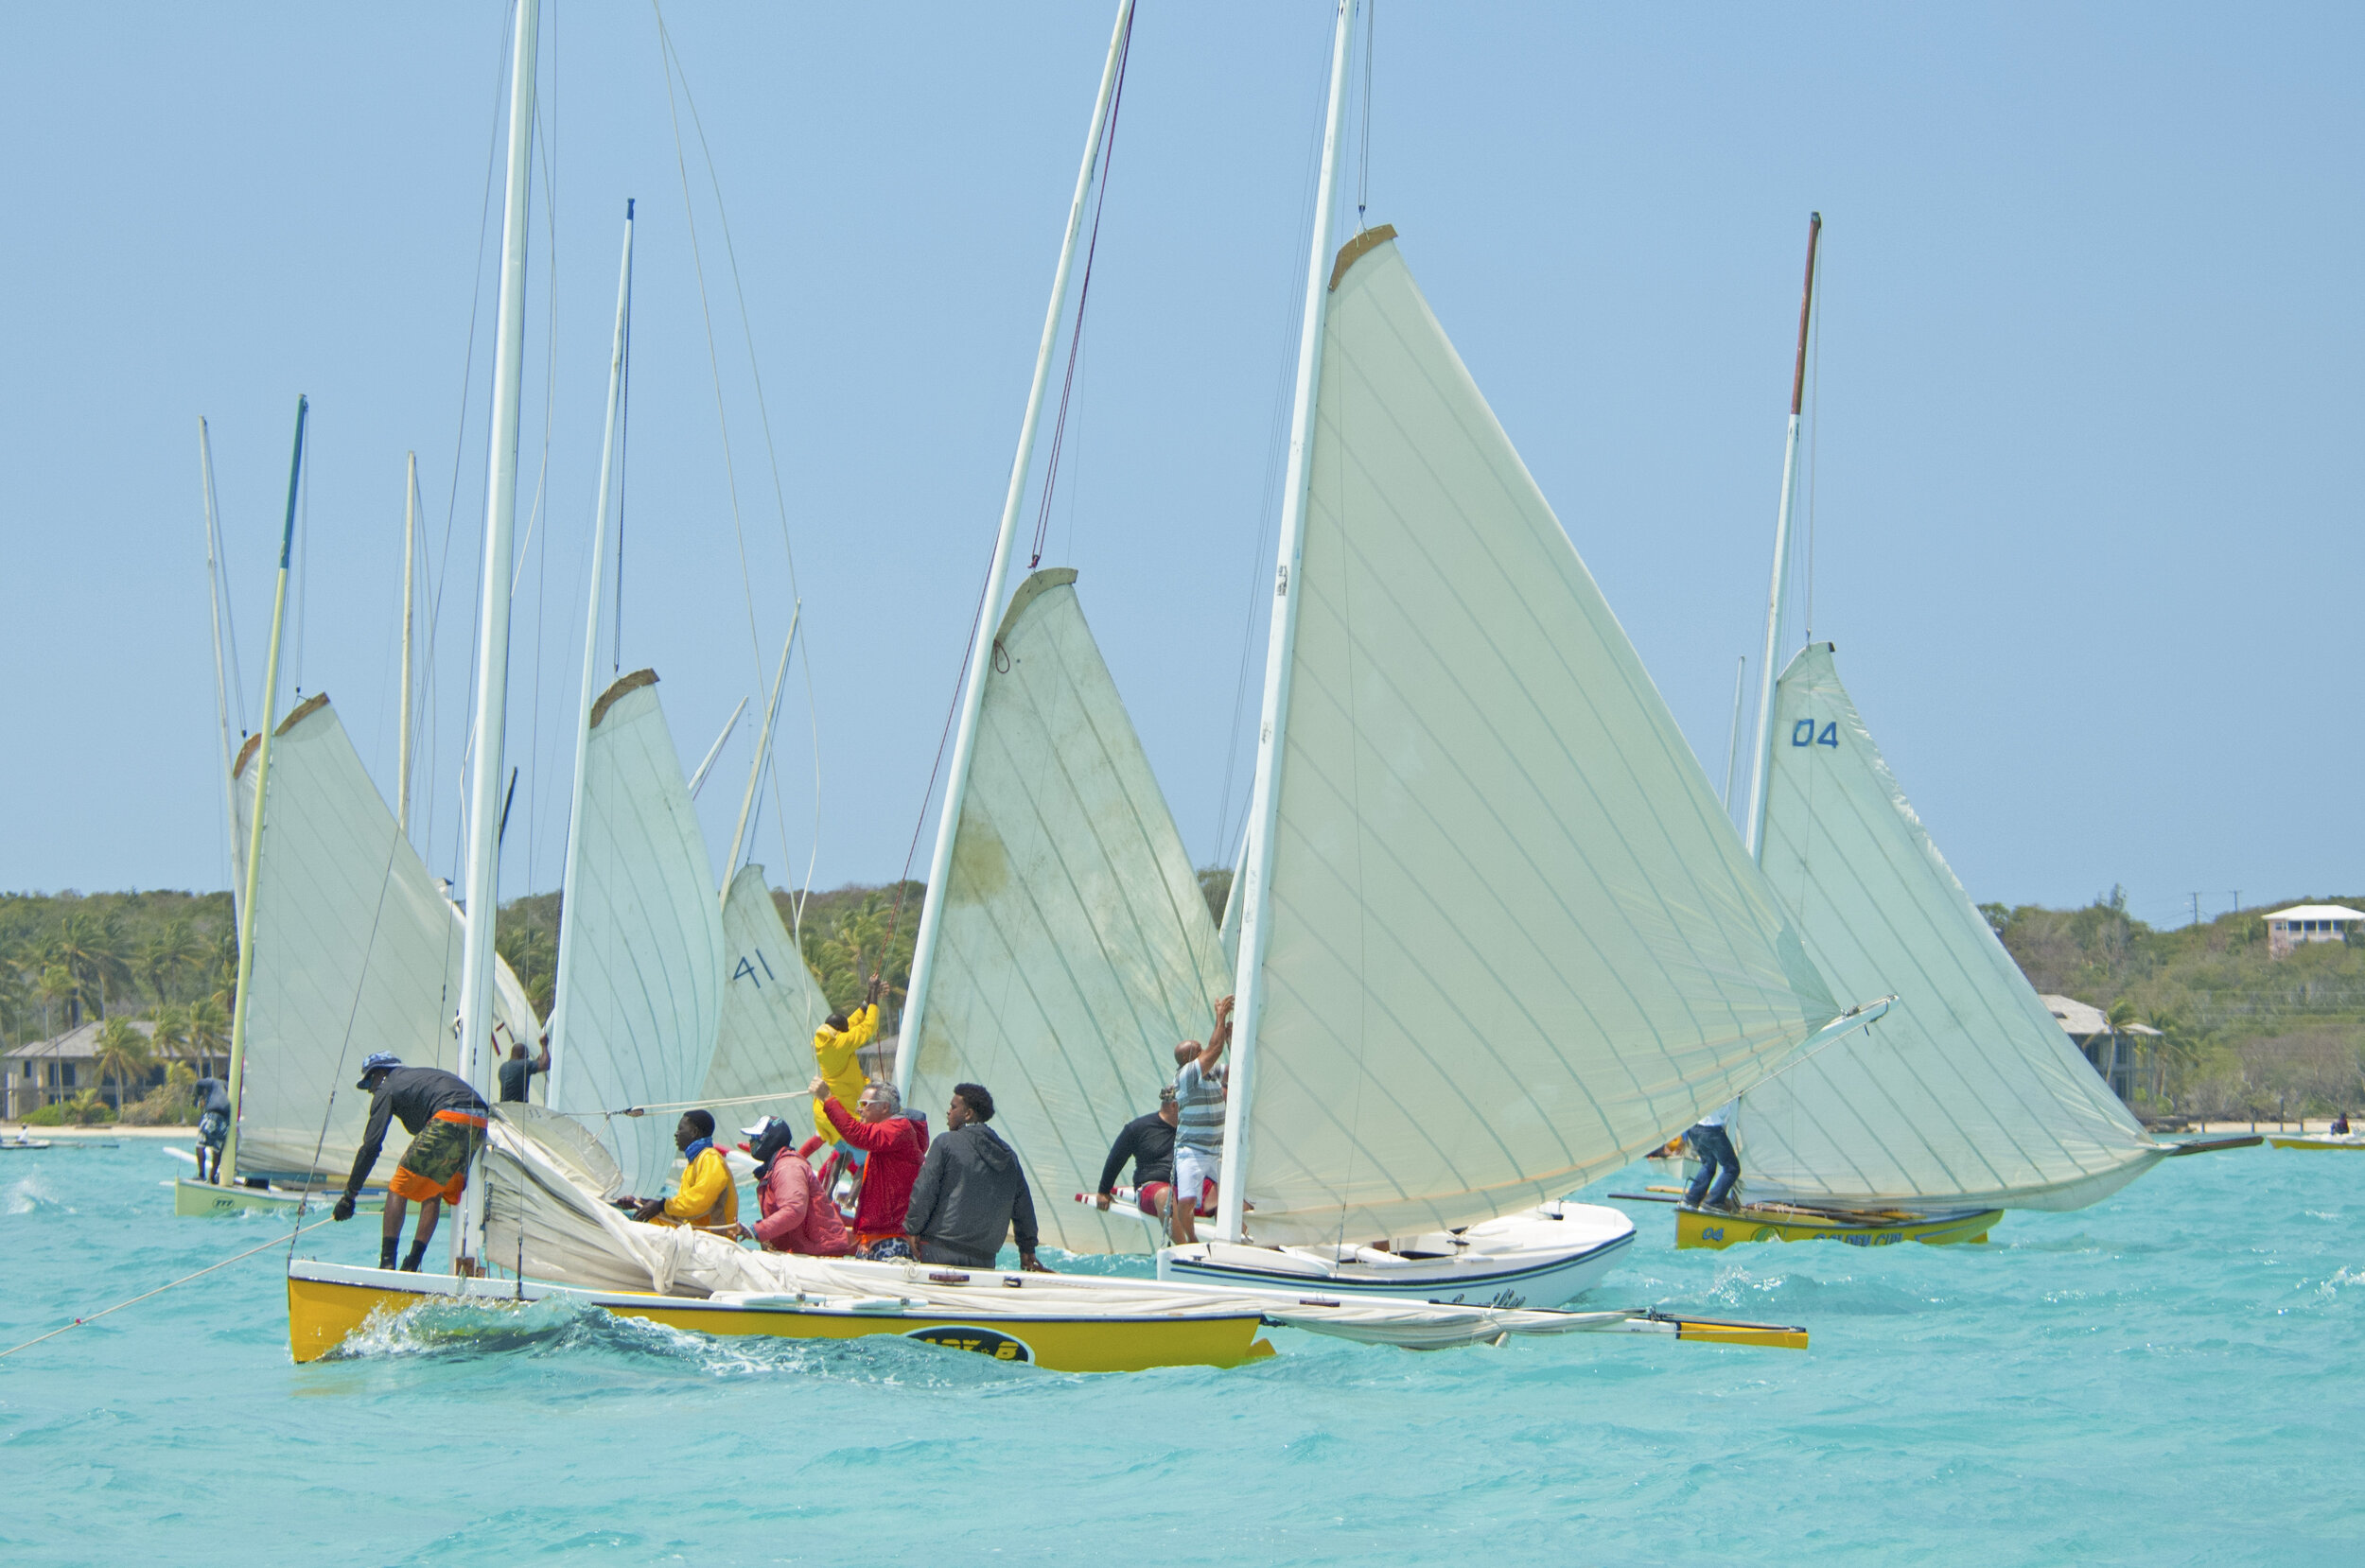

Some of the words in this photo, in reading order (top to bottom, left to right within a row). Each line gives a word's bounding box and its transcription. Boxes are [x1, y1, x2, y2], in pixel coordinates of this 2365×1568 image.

[1793, 719, 1838, 749] 04
[733, 948, 774, 988] 41
[1702, 1227, 1725, 1242] 04
